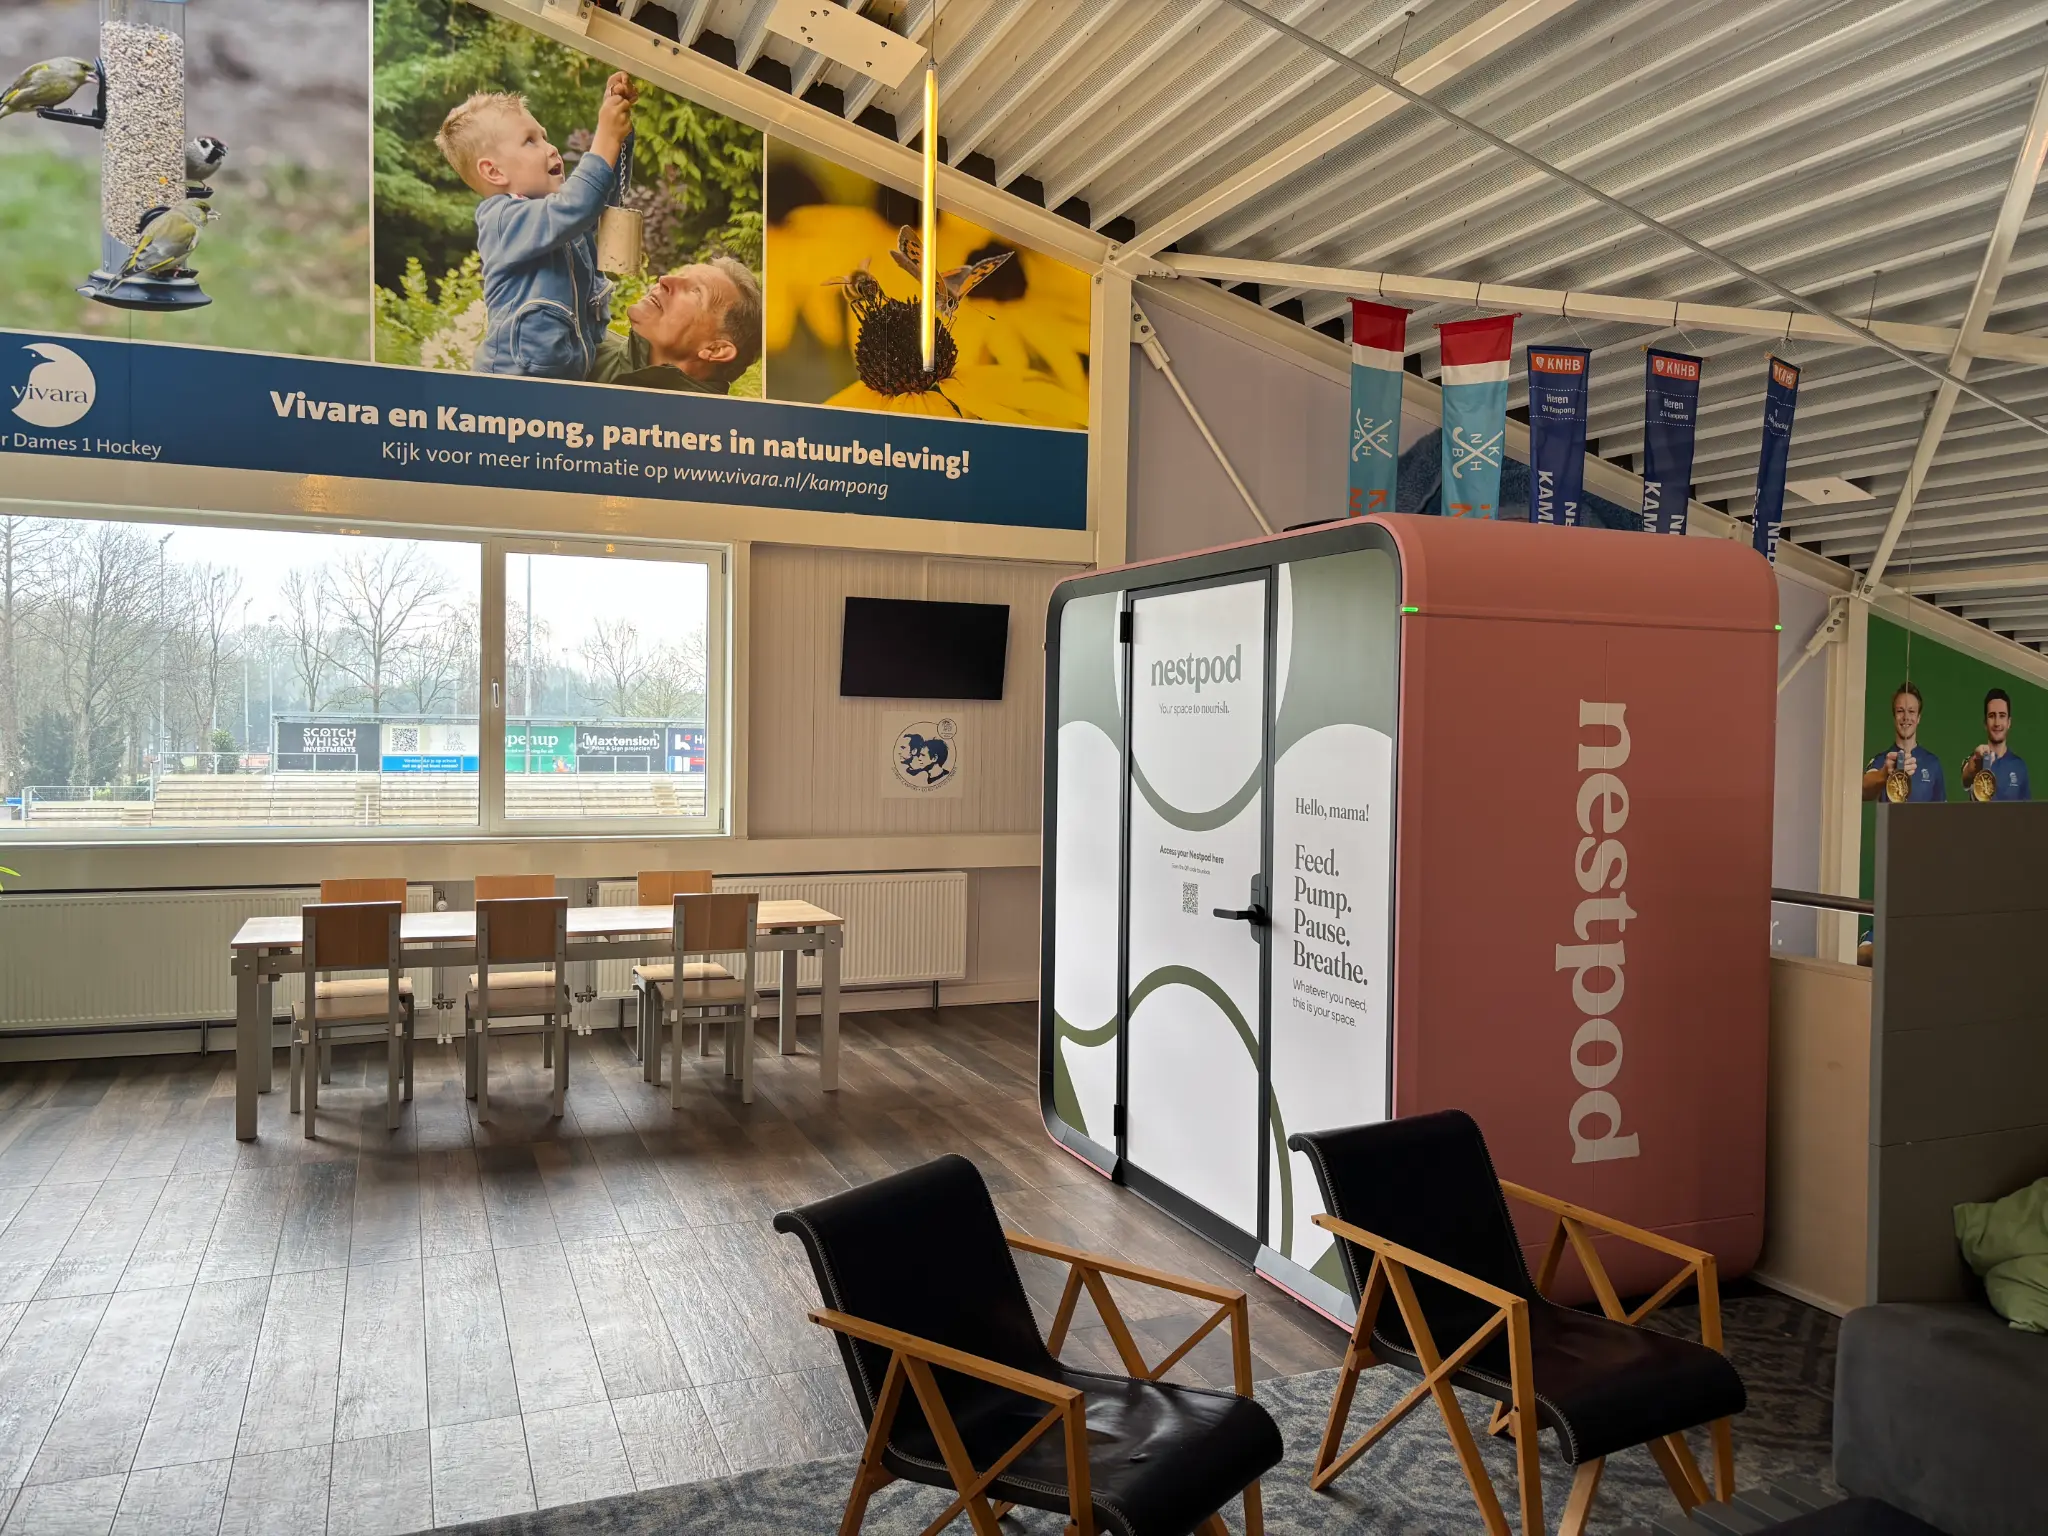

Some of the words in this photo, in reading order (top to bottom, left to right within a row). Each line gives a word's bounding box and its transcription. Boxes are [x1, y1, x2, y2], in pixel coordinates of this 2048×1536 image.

[1547, 357, 1581, 371] KNHB
[1666, 361, 1697, 377] KNHB
[11, 383, 88, 403] vivara
[1546, 393, 1569, 404] Heren
[1664, 398, 1684, 410] Heren
[14, 432, 77, 450] Dames
[82, 437, 92, 452] 1
[96, 438, 162, 460] Hockey
[270, 390, 379, 425] Vivara
[388, 407, 427, 429] en
[437, 406, 595, 449] Kampong,
[603, 424, 722, 453] partners
[729, 428, 755, 455] in
[763, 436, 970, 480] natuurbeleving!
[382, 441, 420, 466] Kijk
[426, 448, 472, 465] voor
[478, 451, 530, 469] meer
[536, 451, 639, 477] informatie
[644, 464, 668, 483] op
[674, 467, 889, 501] www.vivara.nl/kampong
[1151, 643, 1242, 693] nestpod
[1159, 703, 1173, 714] Your
[1174, 704, 1193, 716] space
[1193, 704, 1200, 714] to
[1201, 700, 1230, 714] nourish.
[303, 727, 357, 737] SCOTCH
[303, 737, 356, 747] WHISKY
[585, 735, 657, 747] Maxtension
[1295, 797, 1327, 820] Hello,
[1329, 803, 1369, 821] mama!
[1160, 845, 1177, 856] Access
[1177, 849, 1189, 858] your
[1189, 849, 1211, 862] Nestpod
[1211, 852, 1224, 864] here
[1295, 843, 1339, 877] Feed.
[1294, 875, 1352, 919] Pump.
[1294, 907, 1350, 947] Pause.
[1556, 698, 1640, 1165] nestpod
[1293, 939, 1368, 986] Breathe.
[1293, 977, 1328, 999] Whatever
[1328, 992, 1344, 1005] you
[1344, 996, 1367, 1014] need,
[1292, 996, 1305, 1011] this
[1306, 999, 1312, 1013] is
[1313, 1005, 1331, 1017] your
[1331, 1011, 1357, 1028] space.
